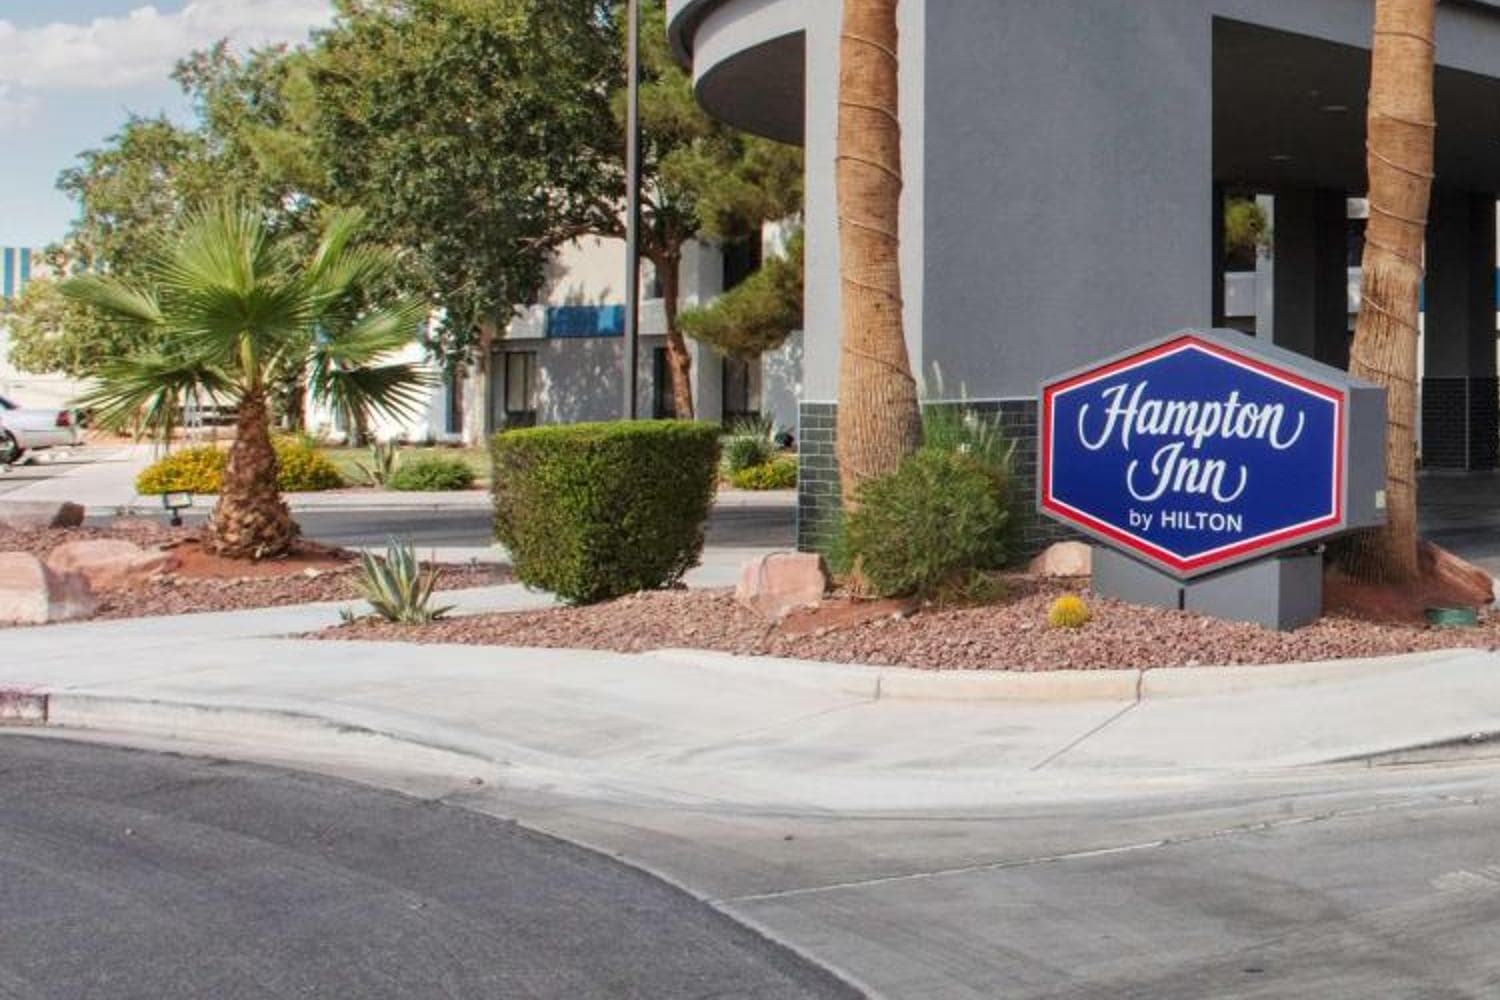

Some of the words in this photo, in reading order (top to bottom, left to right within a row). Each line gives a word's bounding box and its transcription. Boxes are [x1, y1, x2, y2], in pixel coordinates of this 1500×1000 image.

[1078, 380, 1305, 450] Hampton
[1127, 441, 1247, 503] Inn
[1129, 509, 1152, 531] by
[1160, 510, 1243, 533] HILTON
